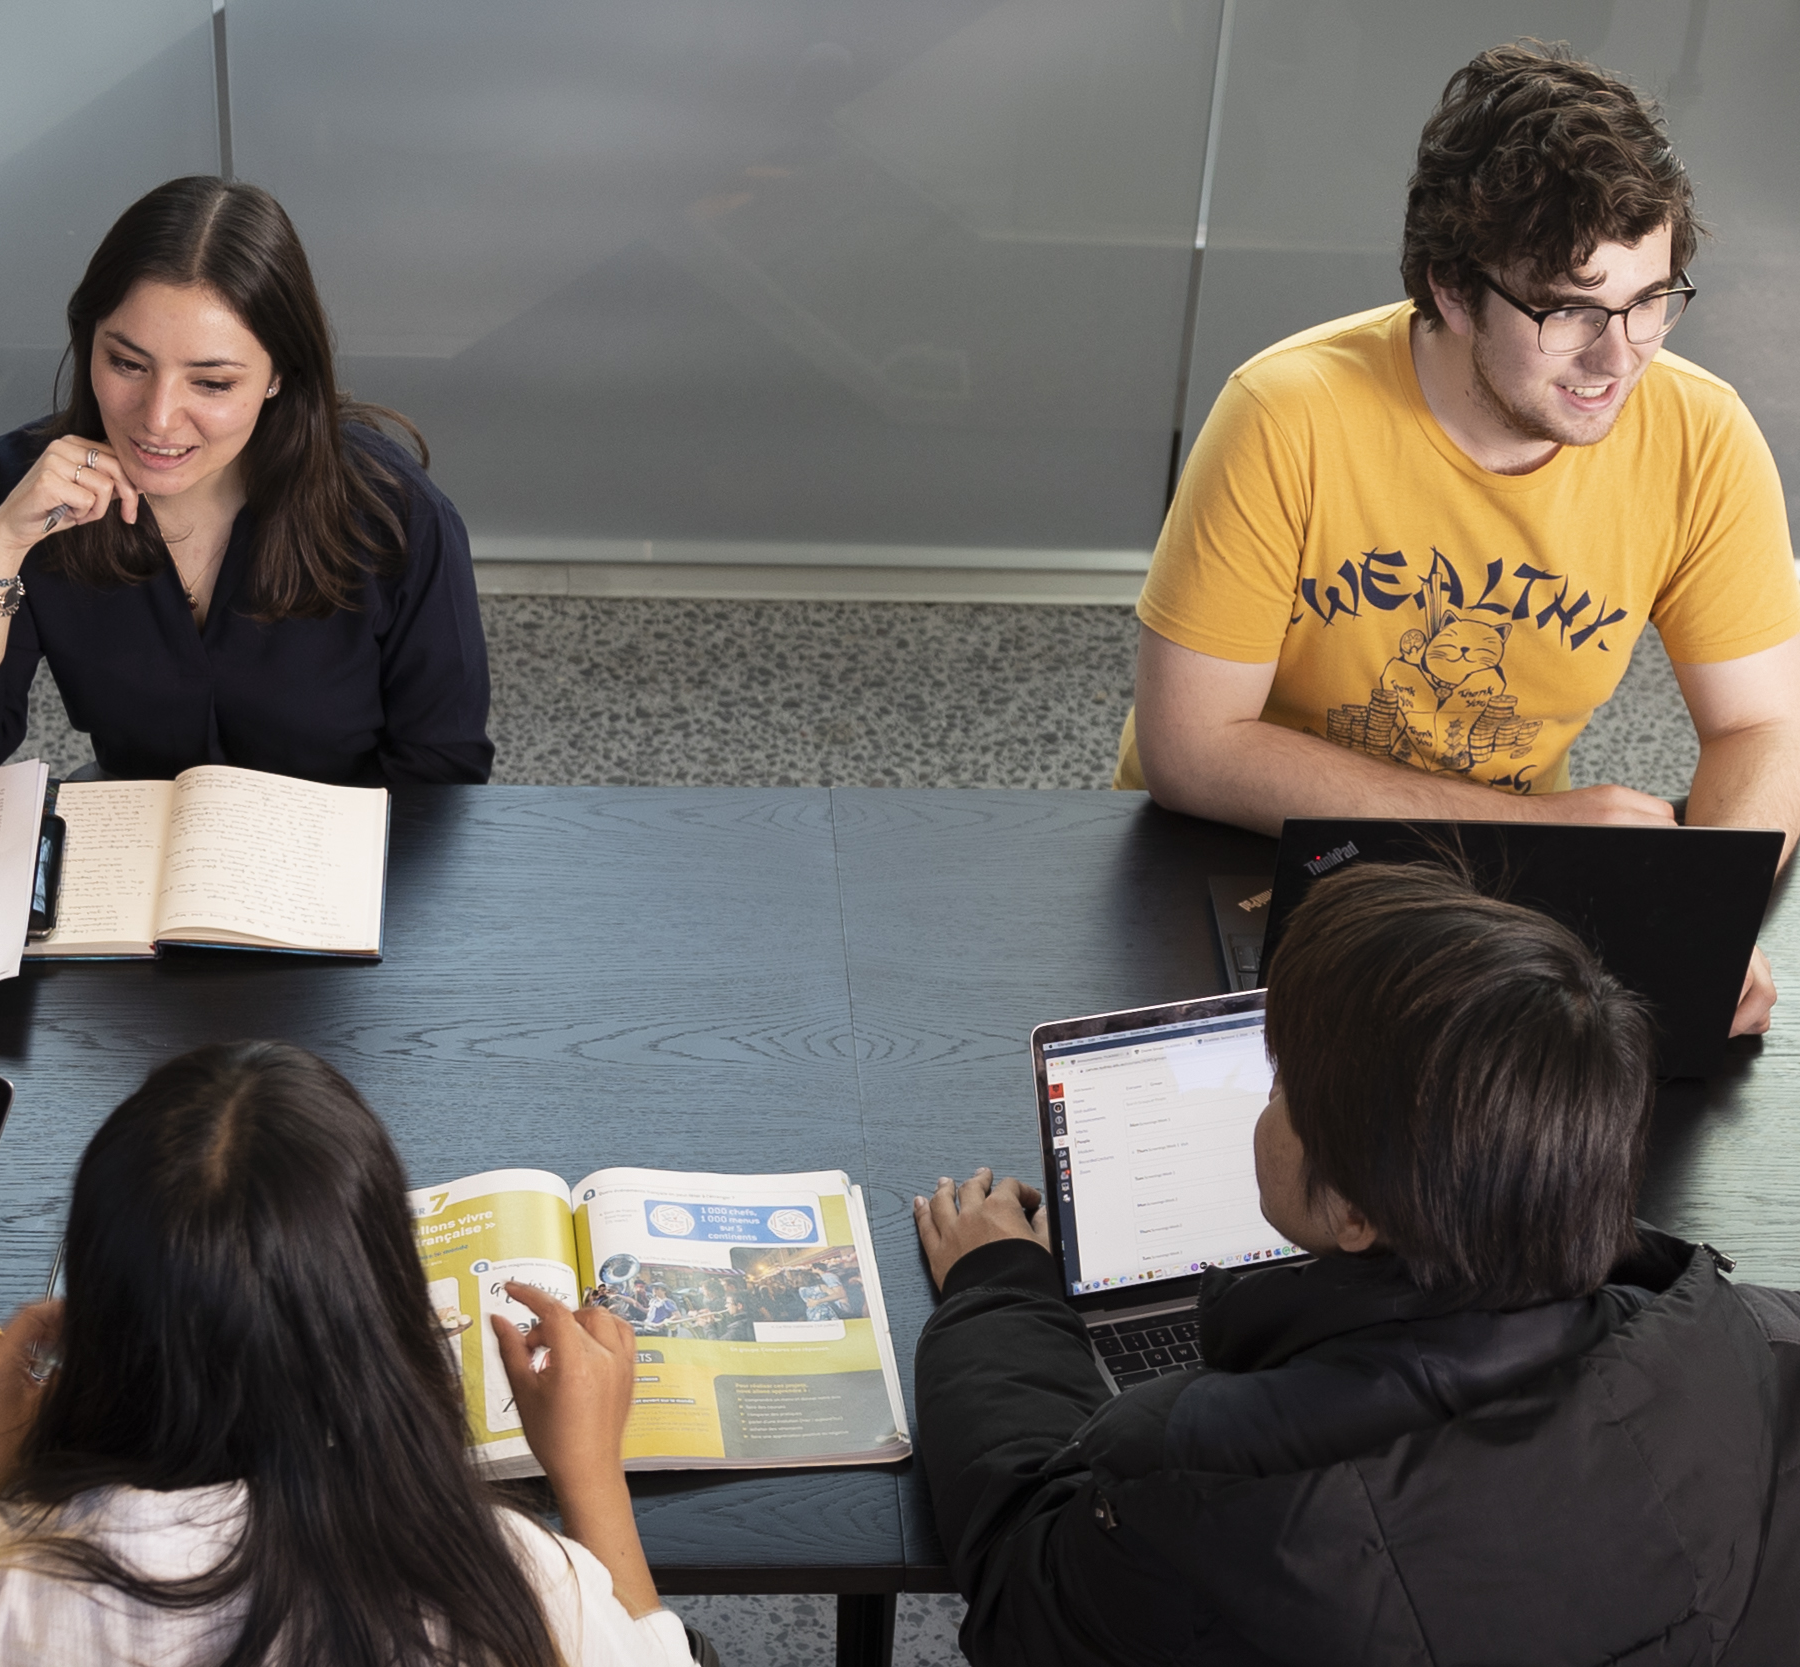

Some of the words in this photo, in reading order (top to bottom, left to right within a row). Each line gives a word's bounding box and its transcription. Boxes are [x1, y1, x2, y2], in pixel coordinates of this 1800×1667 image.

[1301, 545, 1628, 652] WEALTHY
[1303, 840, 1359, 875] ThinkPad
[429, 1192, 450, 1213] 7
[458, 1210, 494, 1226] vivre
[707, 1207, 727, 1215] 000
[729, 1208, 757, 1217] chefs,
[729, 1217, 760, 1225] menus
[708, 1233, 758, 1242] continents
[478, 1263, 486, 1271] 2
